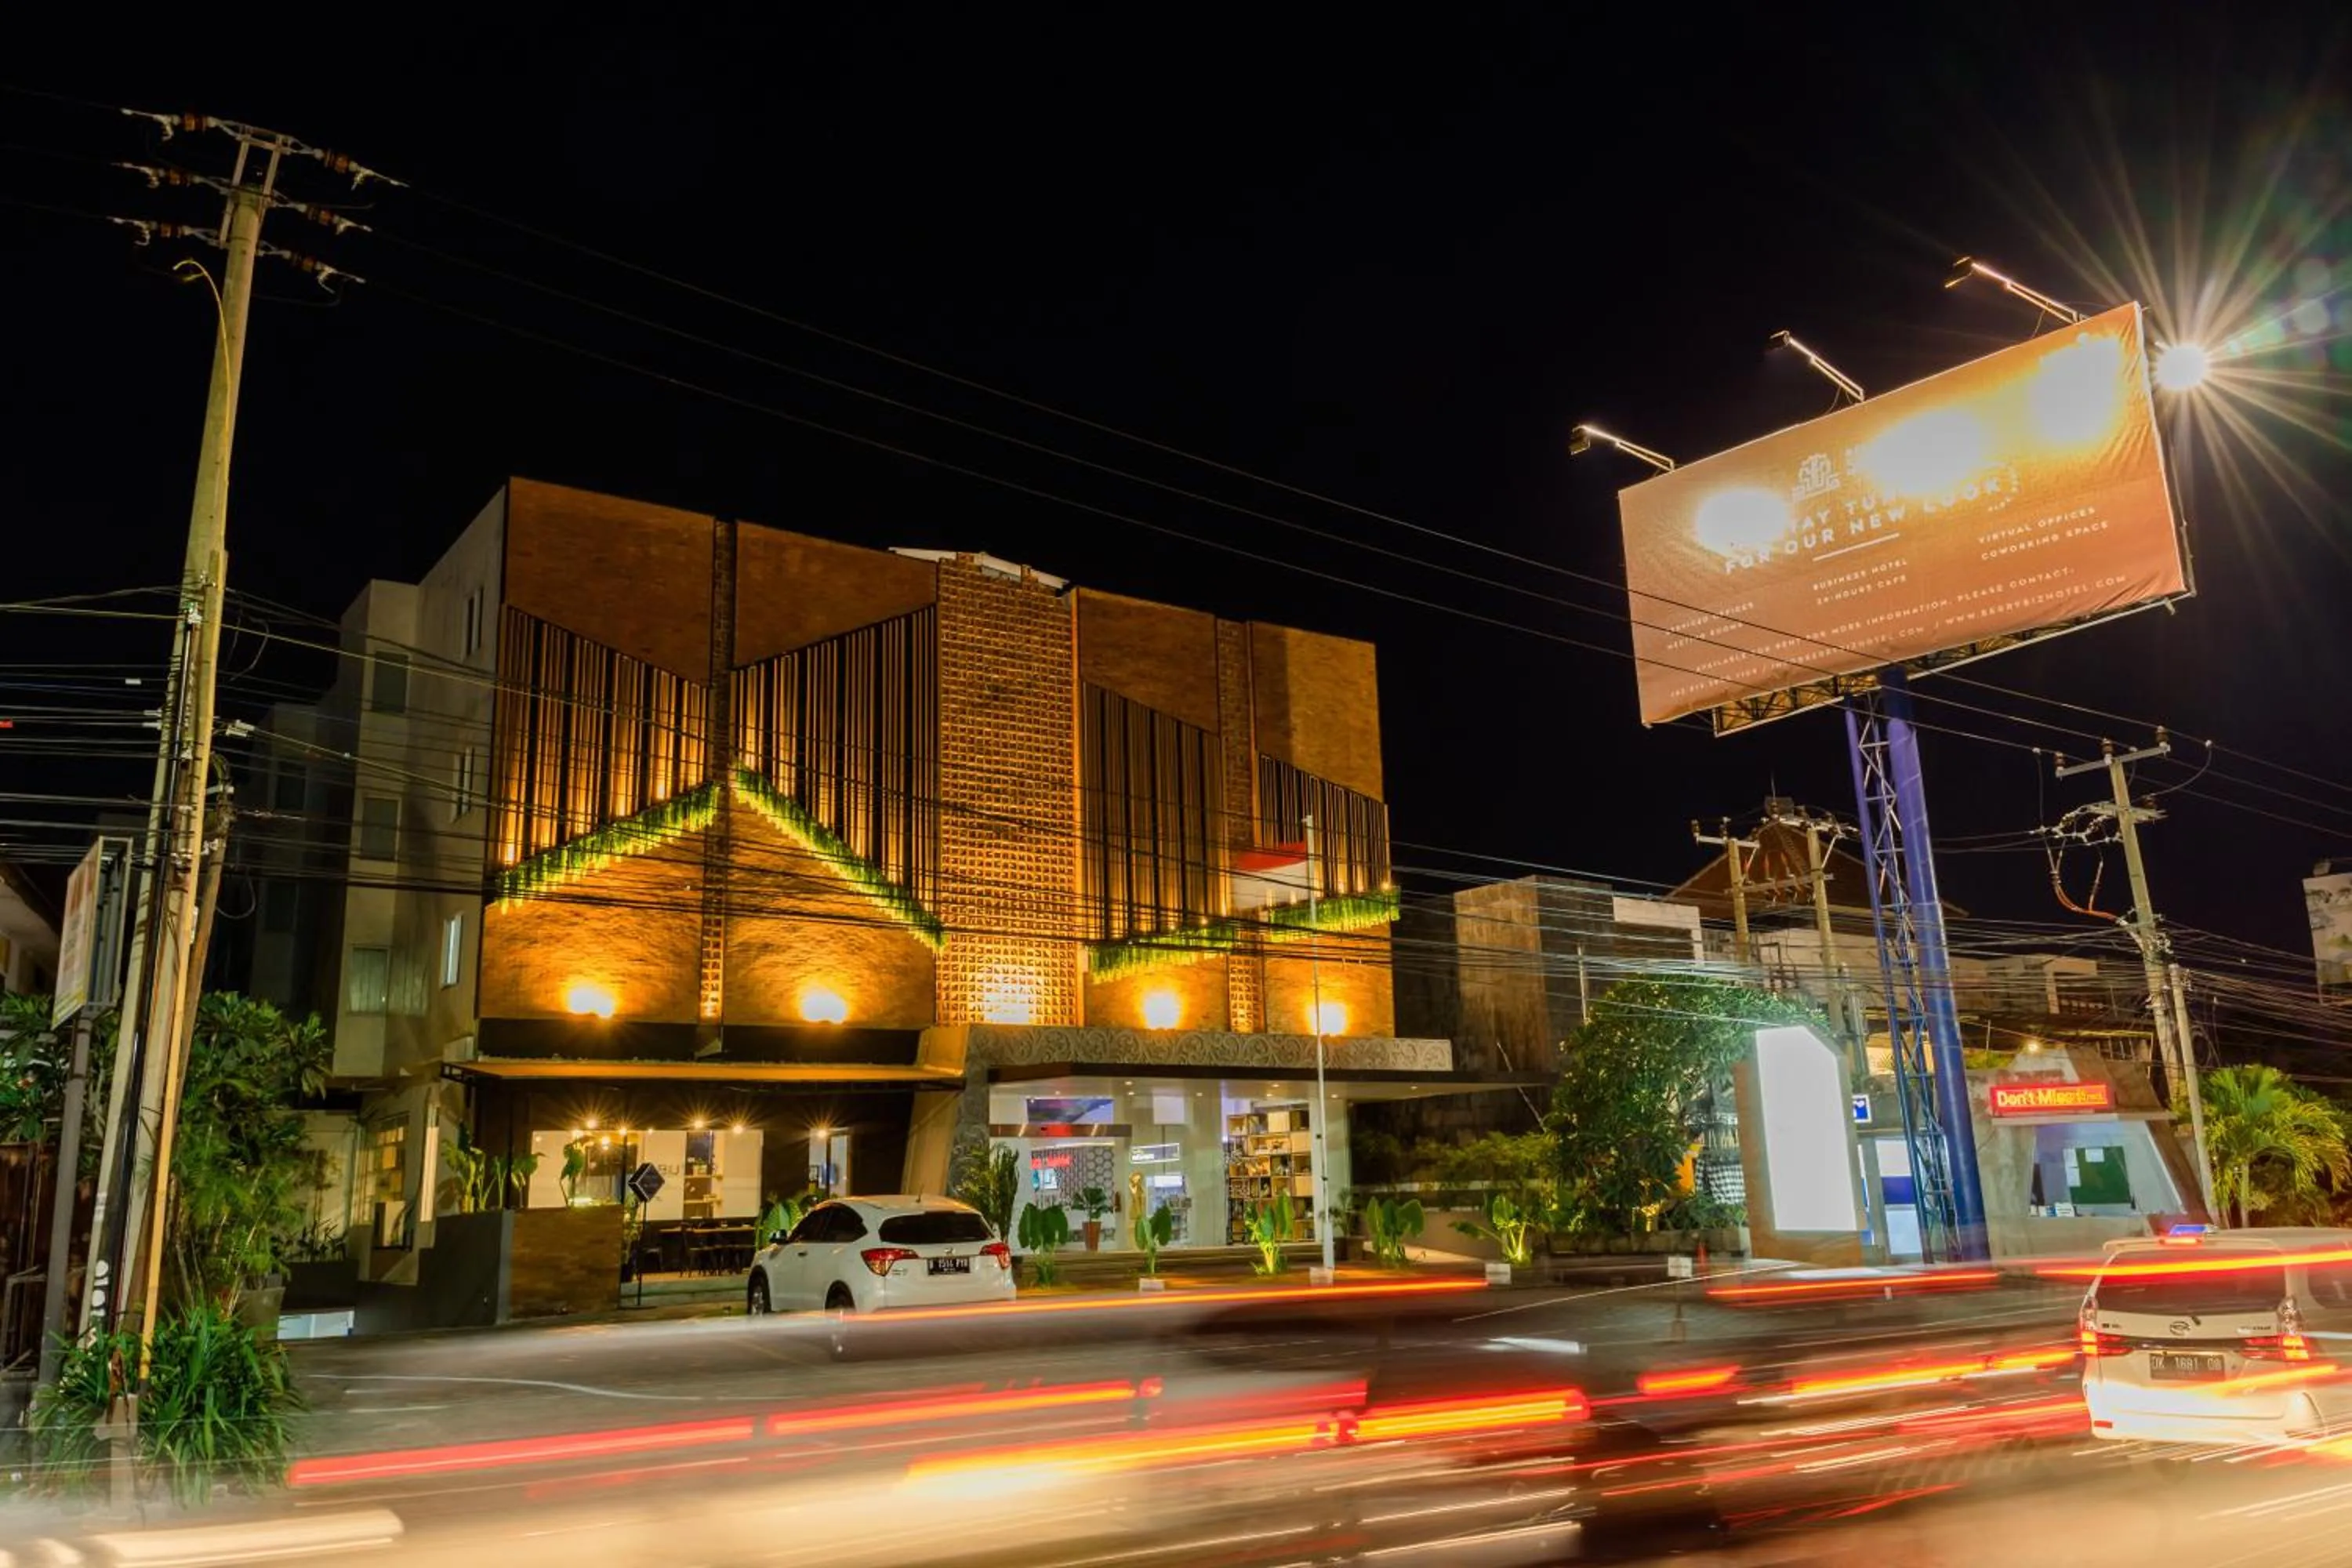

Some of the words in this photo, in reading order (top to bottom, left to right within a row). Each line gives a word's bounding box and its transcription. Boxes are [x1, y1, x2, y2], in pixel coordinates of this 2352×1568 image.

[1783, 527, 1835, 556] OUR
[1849, 504, 1907, 536] NEW
[1977, 522, 2032, 546] VIRTUAL
[2036, 503, 2096, 530] OFFICES
[1980, 531, 2060, 562] COWORKING
[2064, 518, 2109, 539] SPACE
[1812, 569, 1867, 592] BUSINESS
[1871, 557, 1907, 575] HOTEL
[1956, 583, 2004, 603] PLEASE
[1997, 1091, 2034, 1106] Don't
